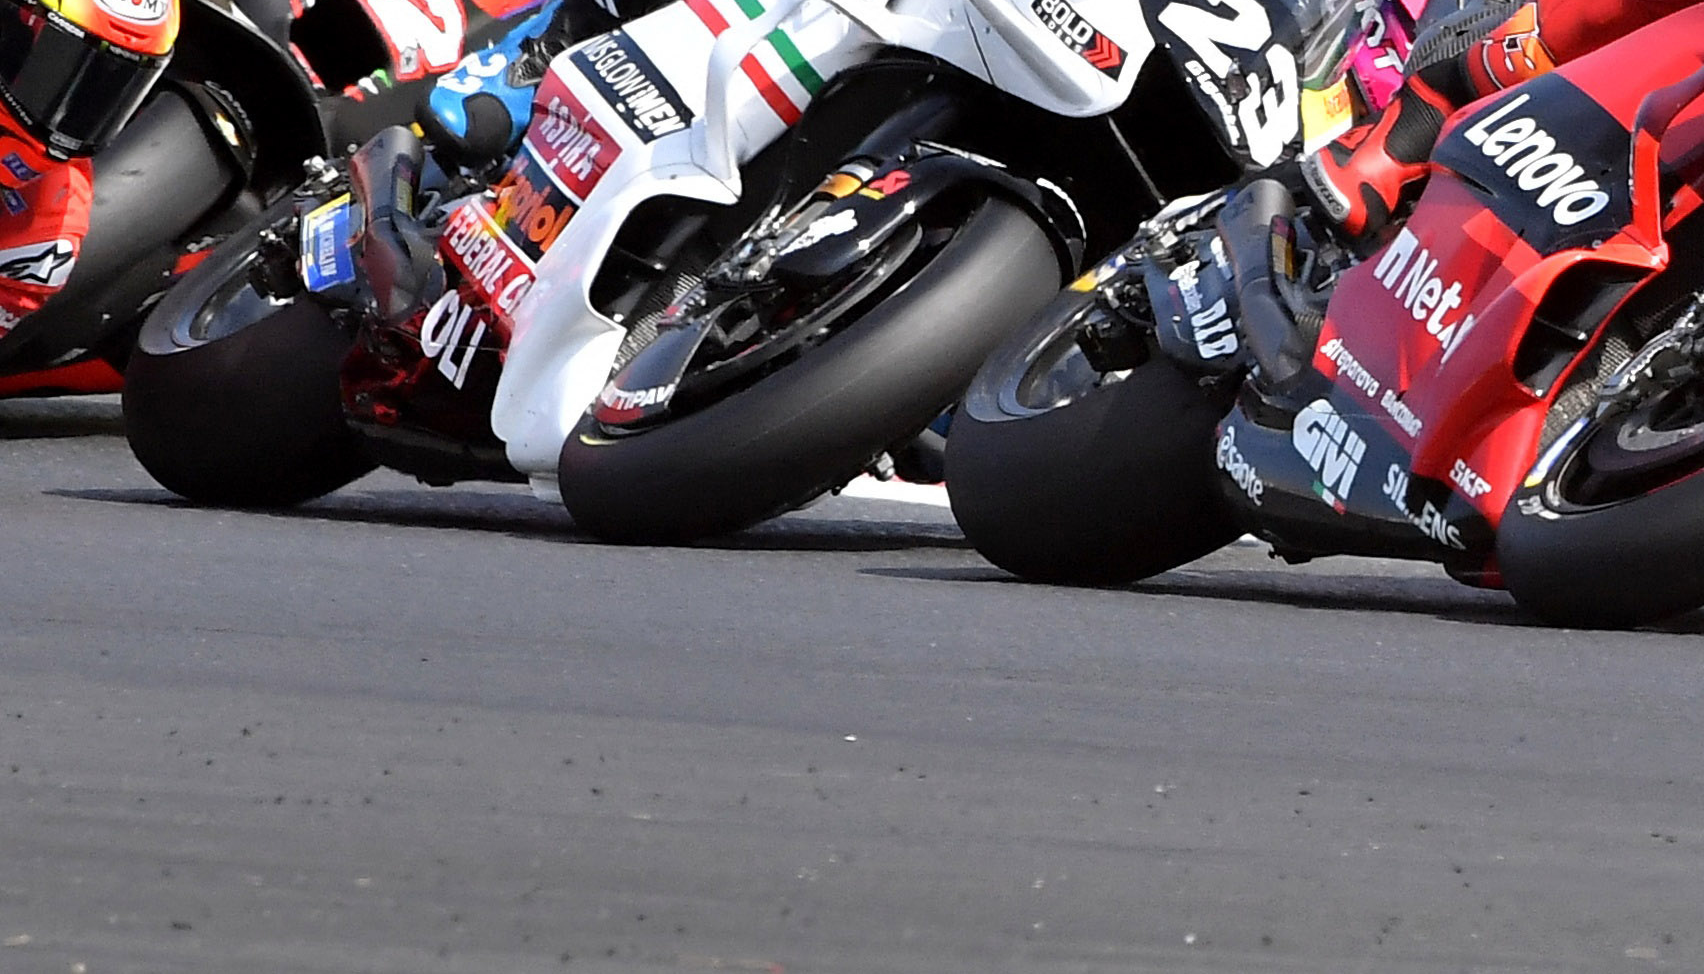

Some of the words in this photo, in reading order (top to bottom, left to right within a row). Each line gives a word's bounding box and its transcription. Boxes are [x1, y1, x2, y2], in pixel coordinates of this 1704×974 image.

[1036, 5, 1084, 53] RIDERS
[1463, 93, 1610, 226] Lenovo
[444, 205, 513, 294] FEDERAL
[1449, 458, 1492, 498] SKF
